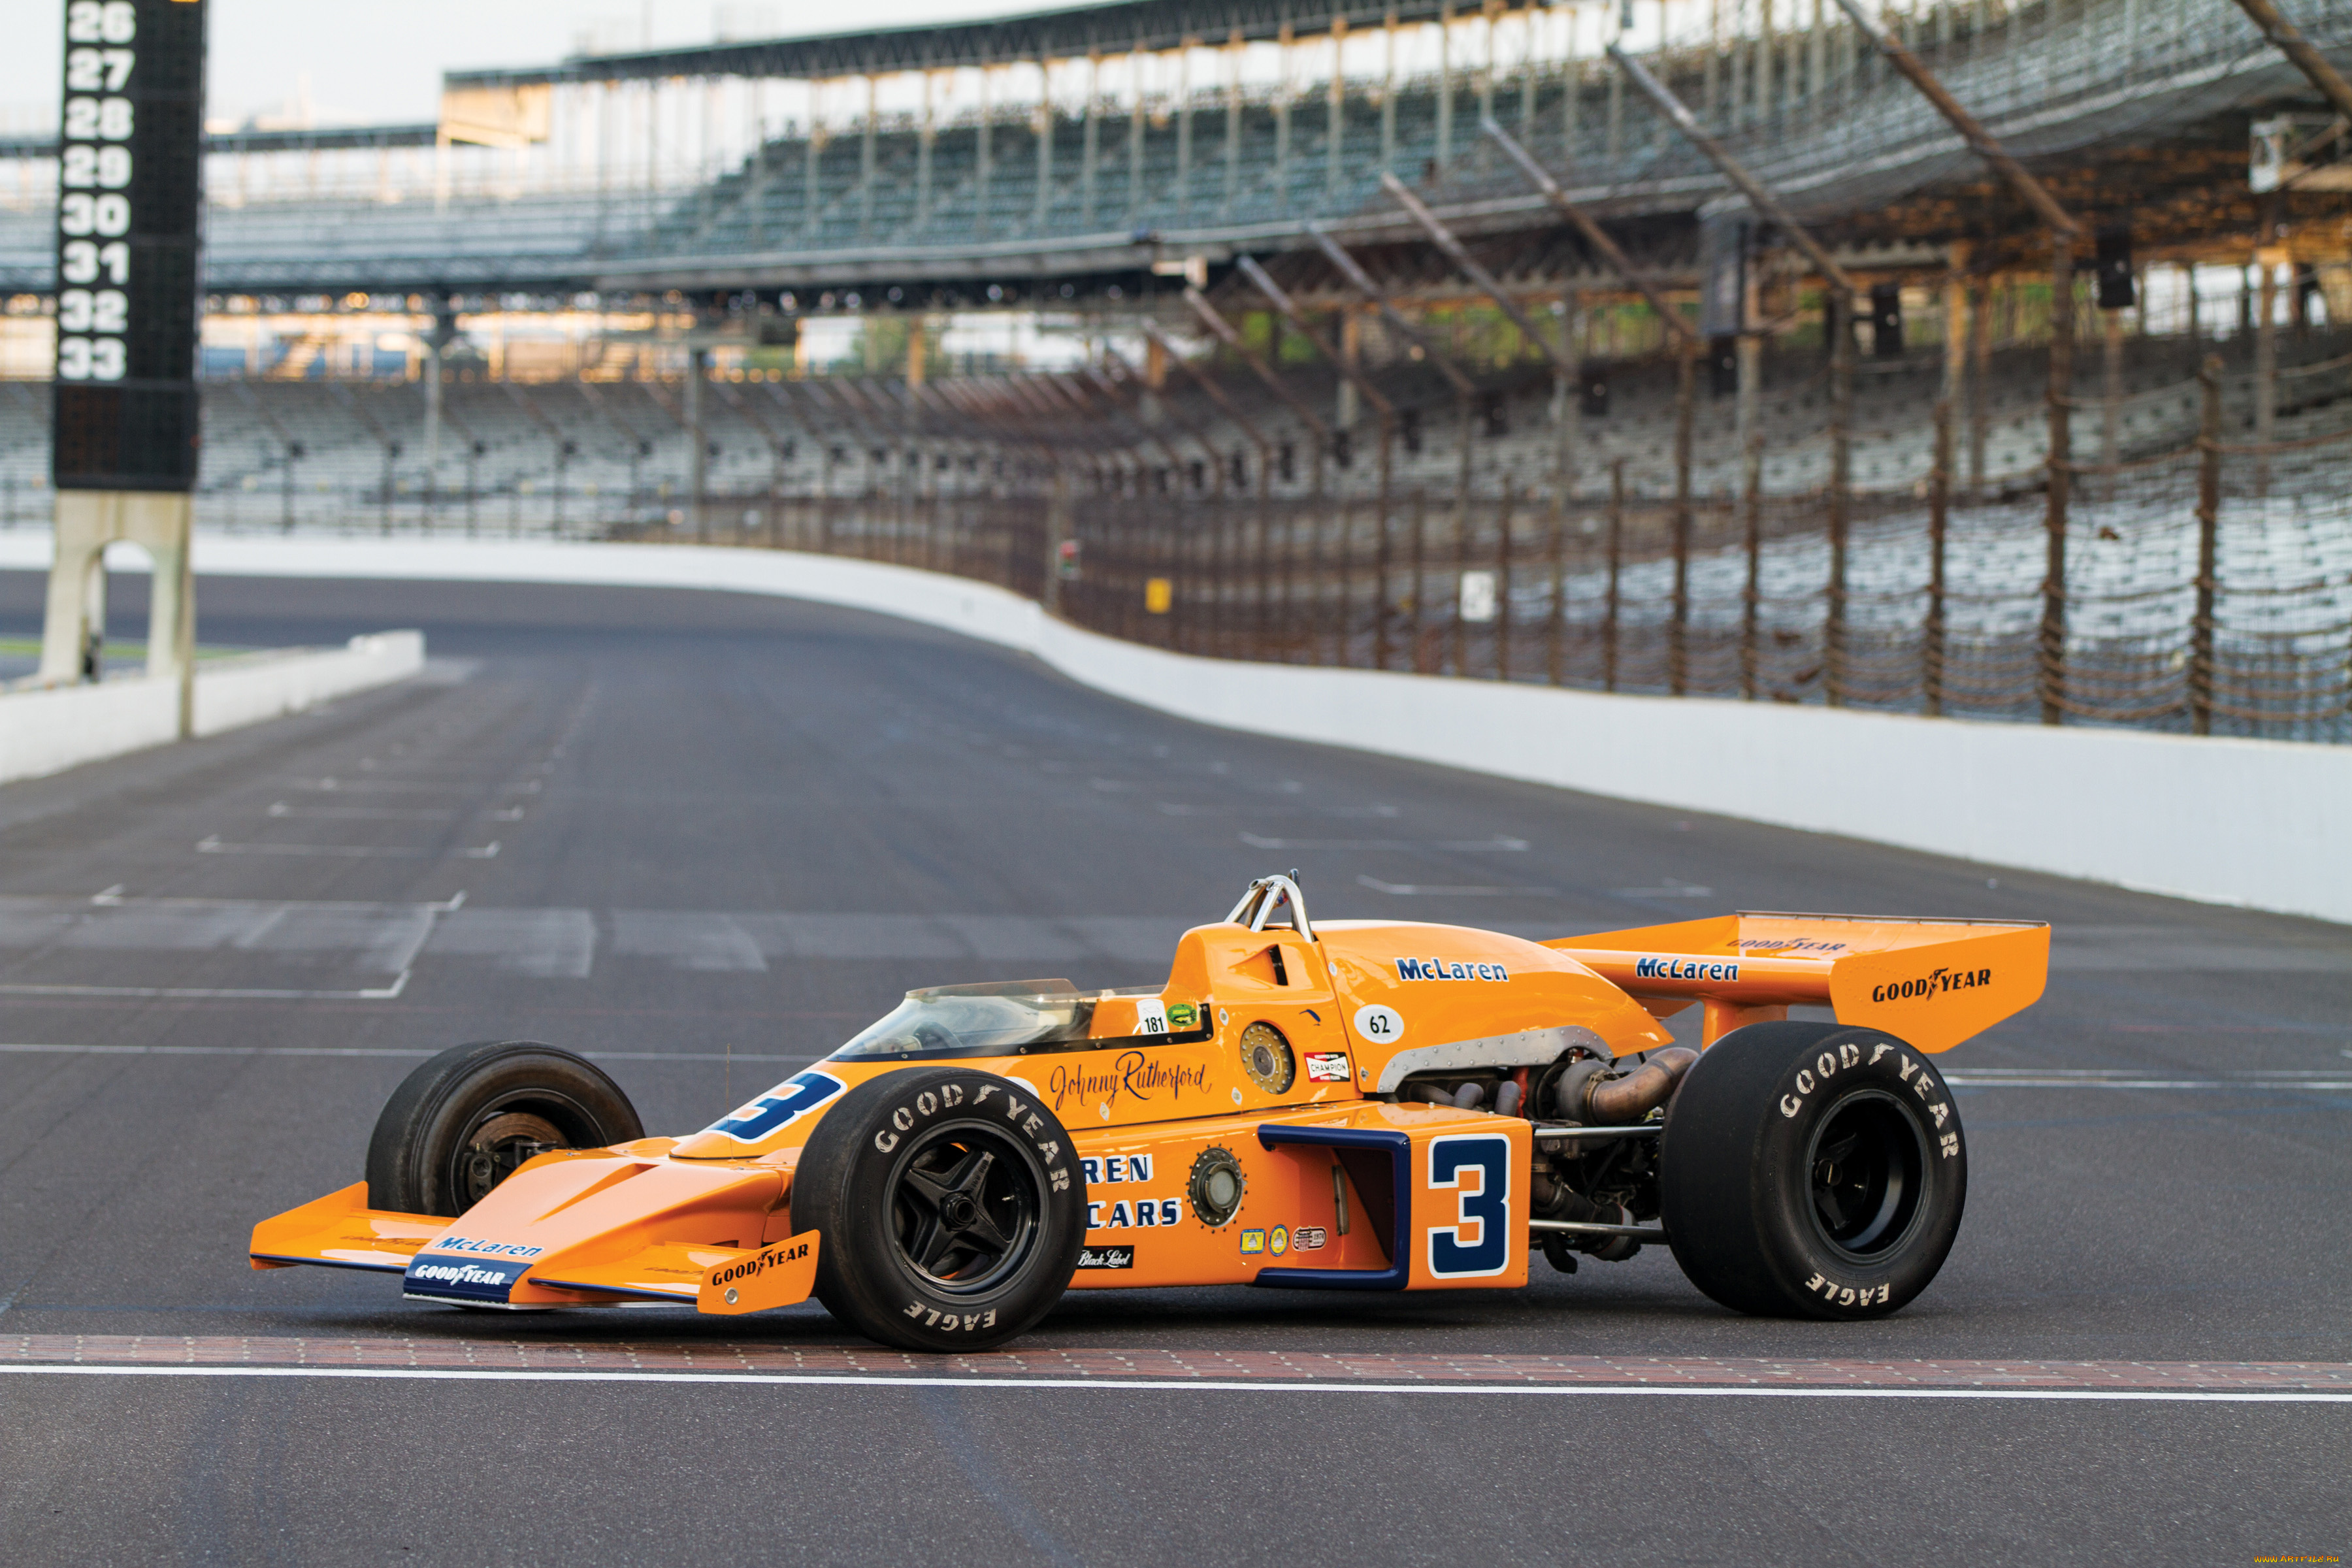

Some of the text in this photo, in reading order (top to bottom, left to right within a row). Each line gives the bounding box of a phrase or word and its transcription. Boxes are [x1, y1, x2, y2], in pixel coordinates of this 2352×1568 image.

[68, 0, 136, 44] 26
[67, 48, 135, 91] 27
[65, 97, 133, 140] 28
[62, 144, 132, 188] 29
[61, 193, 130, 237] 30
[63, 240, 129, 284] 31
[59, 289, 127, 333] 32
[59, 336, 125, 381] 33
[1394, 957, 1510, 982] McLaren
[1635, 956, 1739, 982] McLaren
[1145, 1017, 1164, 1032] 181
[1369, 1015, 1390, 1034] 62
[1050, 1051, 1212, 1111] Johnny Rutherford
[1311, 1063, 1346, 1072] CHAMPION
[696, 1070, 847, 1144] 3
[1086, 1197, 1182, 1230] CARS
[1428, 1133, 1511, 1279] 3
[432, 1236, 545, 1257] McLaren
[1077, 1250, 1131, 1268] Black Label
[1805, 1271, 1890, 1307] EAGLE
[902, 1300, 997, 1331] EAGLE
